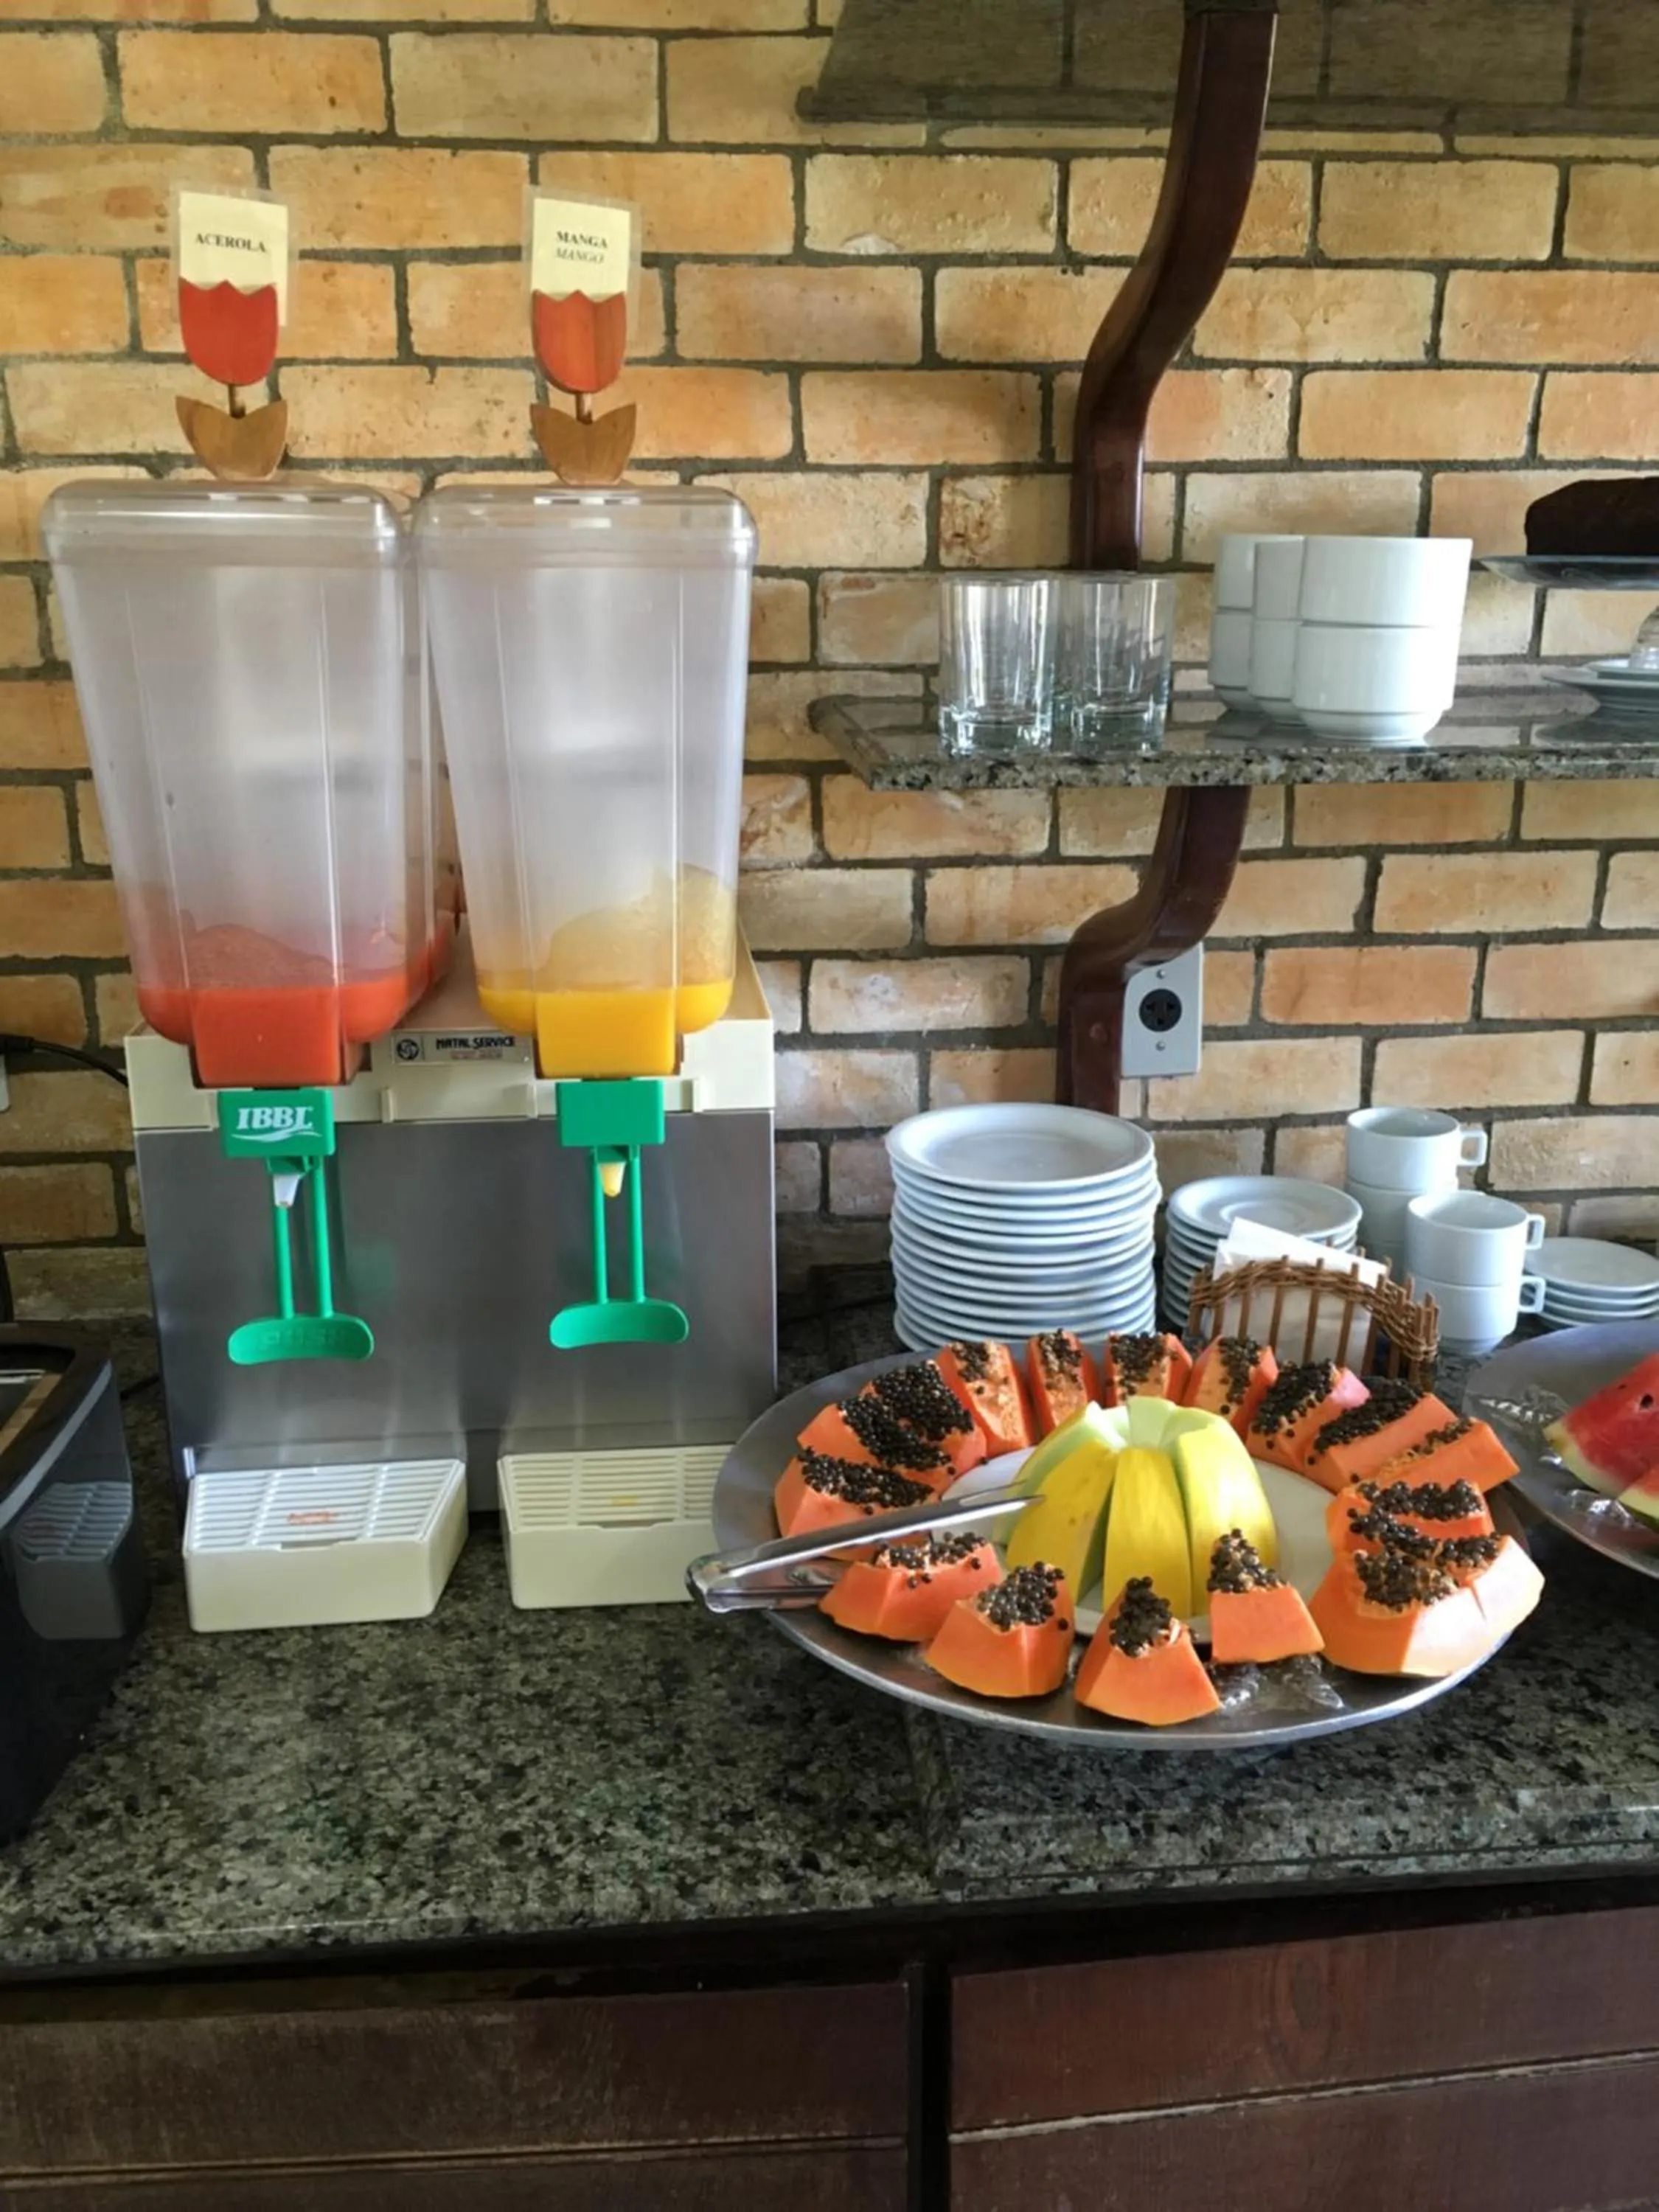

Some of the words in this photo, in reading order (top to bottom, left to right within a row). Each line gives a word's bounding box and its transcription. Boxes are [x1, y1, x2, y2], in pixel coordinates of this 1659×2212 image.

[195, 233, 268, 253] ACEROLA
[557, 231, 608, 248] MANGA
[555, 248, 604, 264] MANGO
[473, 1036, 516, 1050] SERVICE
[236, 1106, 313, 1130] IBBL
